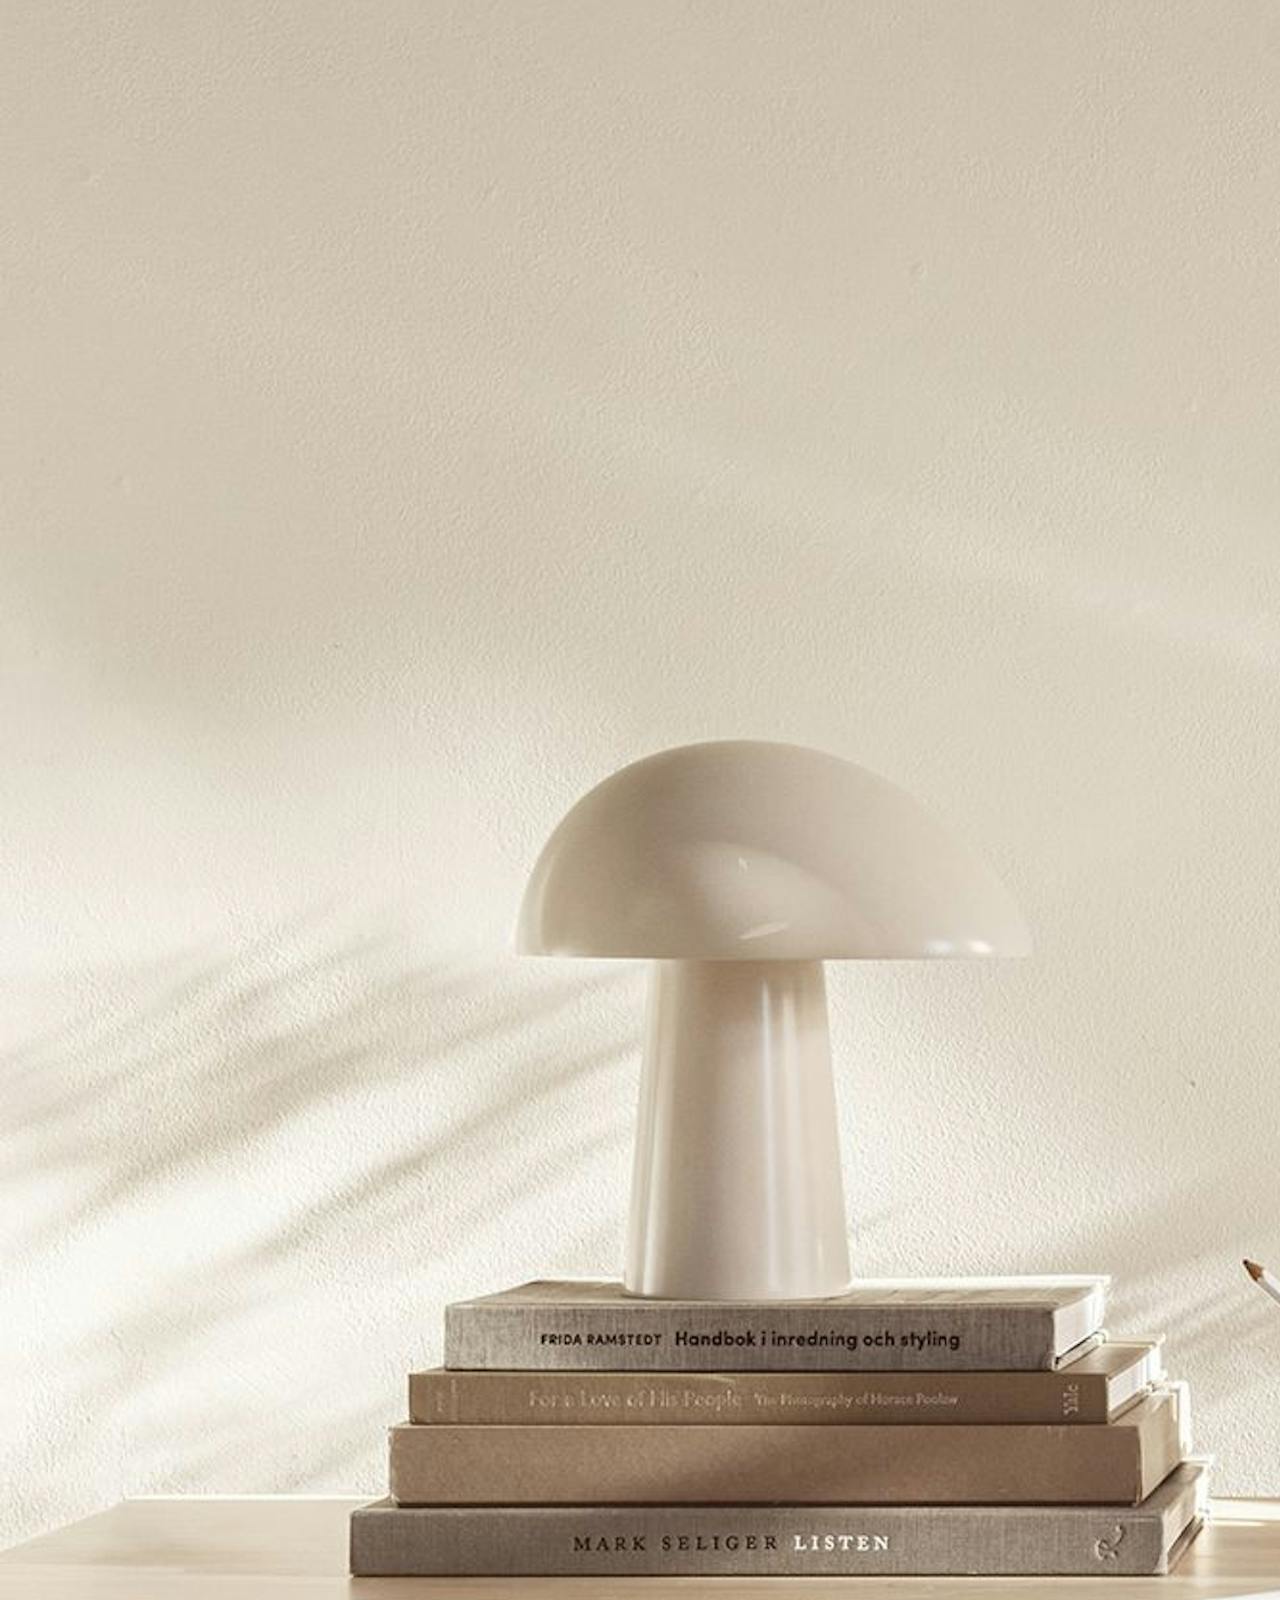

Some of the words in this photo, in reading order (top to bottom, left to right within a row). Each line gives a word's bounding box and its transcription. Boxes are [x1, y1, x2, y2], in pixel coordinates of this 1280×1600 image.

[540, 1333, 583, 1346] FRIDA
[586, 1333, 663, 1346] RAMSTEDT
[674, 1330, 757, 1347] Handbok
[760, 1330, 767, 1347] i
[771, 1330, 858, 1351] inredning
[862, 1330, 896, 1347] och
[900, 1330, 961, 1351] styling
[579, 1389, 619, 1408] Love
[684, 1388, 742, 1412] People
[572, 1535, 647, 1551] MARK
[661, 1535, 778, 1551] SELIGER
[793, 1535, 890, 1551] LISTEN
